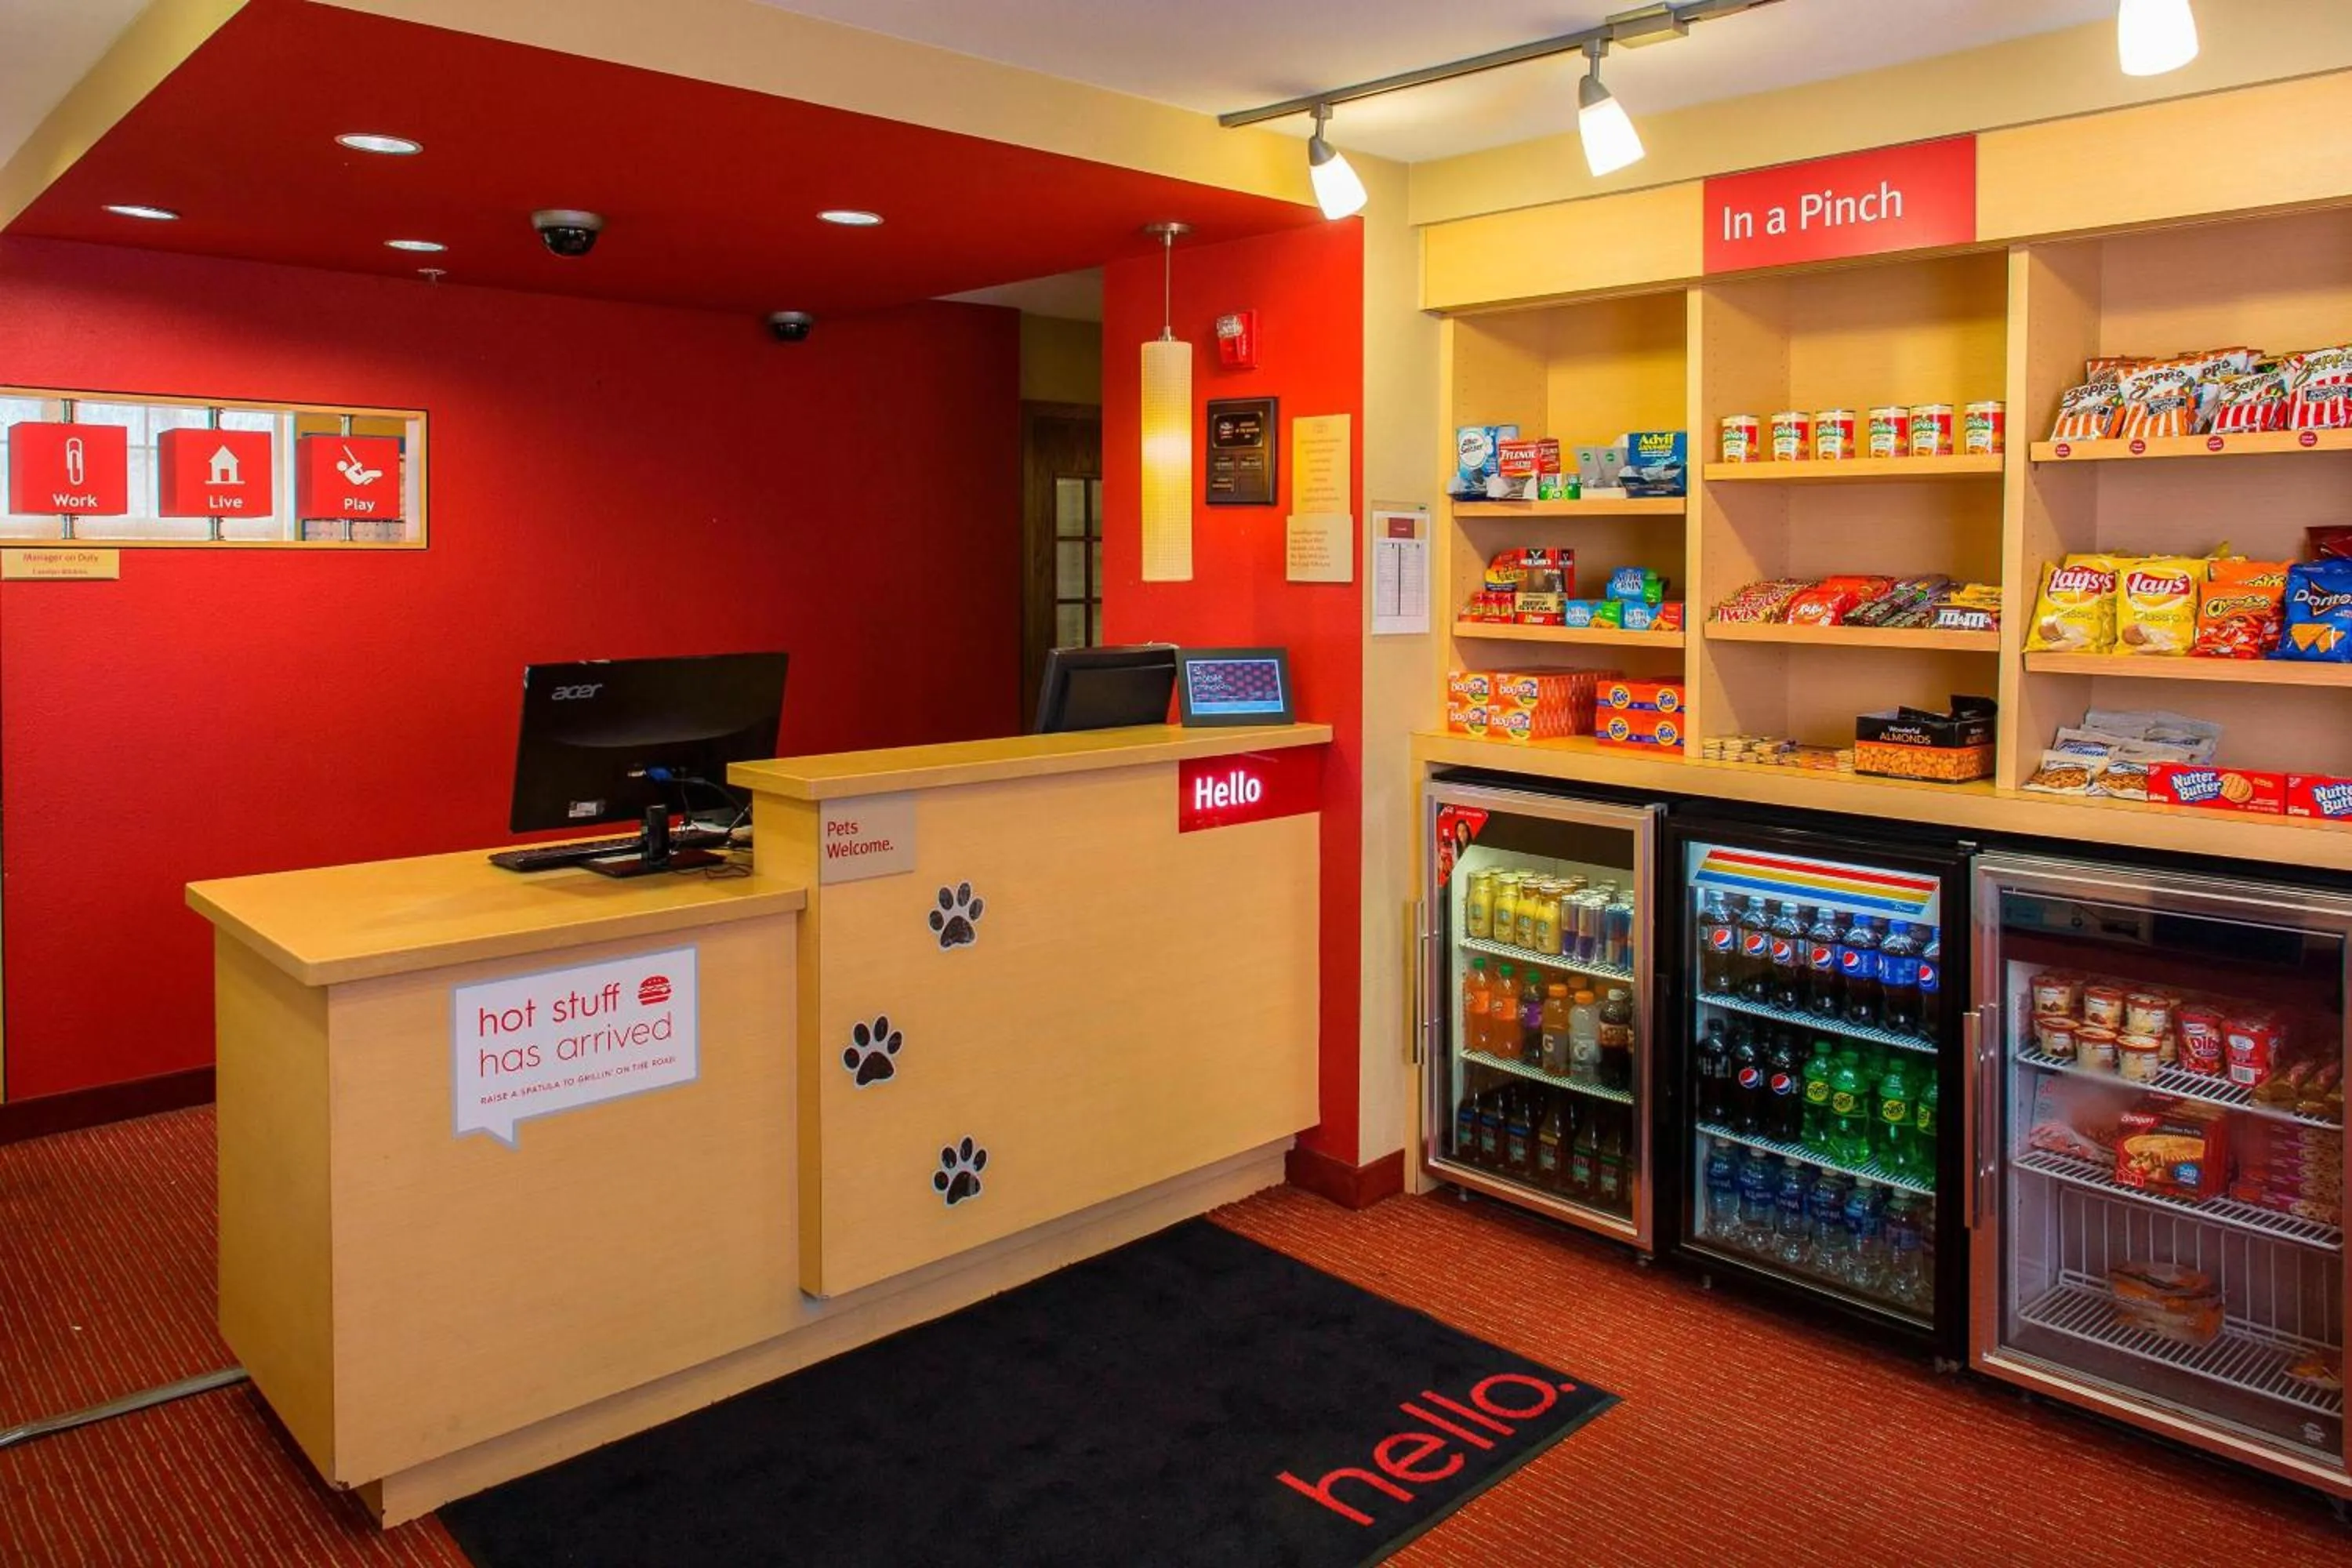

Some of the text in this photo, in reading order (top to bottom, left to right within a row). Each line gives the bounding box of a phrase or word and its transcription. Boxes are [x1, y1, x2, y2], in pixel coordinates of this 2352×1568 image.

[1723, 181, 1903, 241] In a Pinch
[53, 493, 98, 508] Work
[209, 495, 243, 509] Live
[343, 497, 376, 513] Play
[2294, 589, 2352, 606] Dorito
[552, 683, 603, 701] acer
[1879, 731, 1932, 745] ALMONDS
[2171, 771, 2217, 789] Nutter
[1194, 771, 1261, 811] Hello
[2179, 781, 2222, 800] Butter
[2314, 785, 2352, 801] Nutte
[2322, 795, 2352, 815] Butt
[827, 820, 859, 837] Pets
[826, 839, 894, 859] Welcome.
[479, 982, 621, 1037] hot stuff
[479, 1011, 672, 1077] has arrived
[481, 1092, 507, 1105] RAISE
[521, 1081, 561, 1097] SPATULA
[563, 1078, 575, 1087] TO
[615, 1065, 630, 1075] ON
[632, 1062, 648, 1071] THE
[1275, 1373, 1577, 1526] hello.
